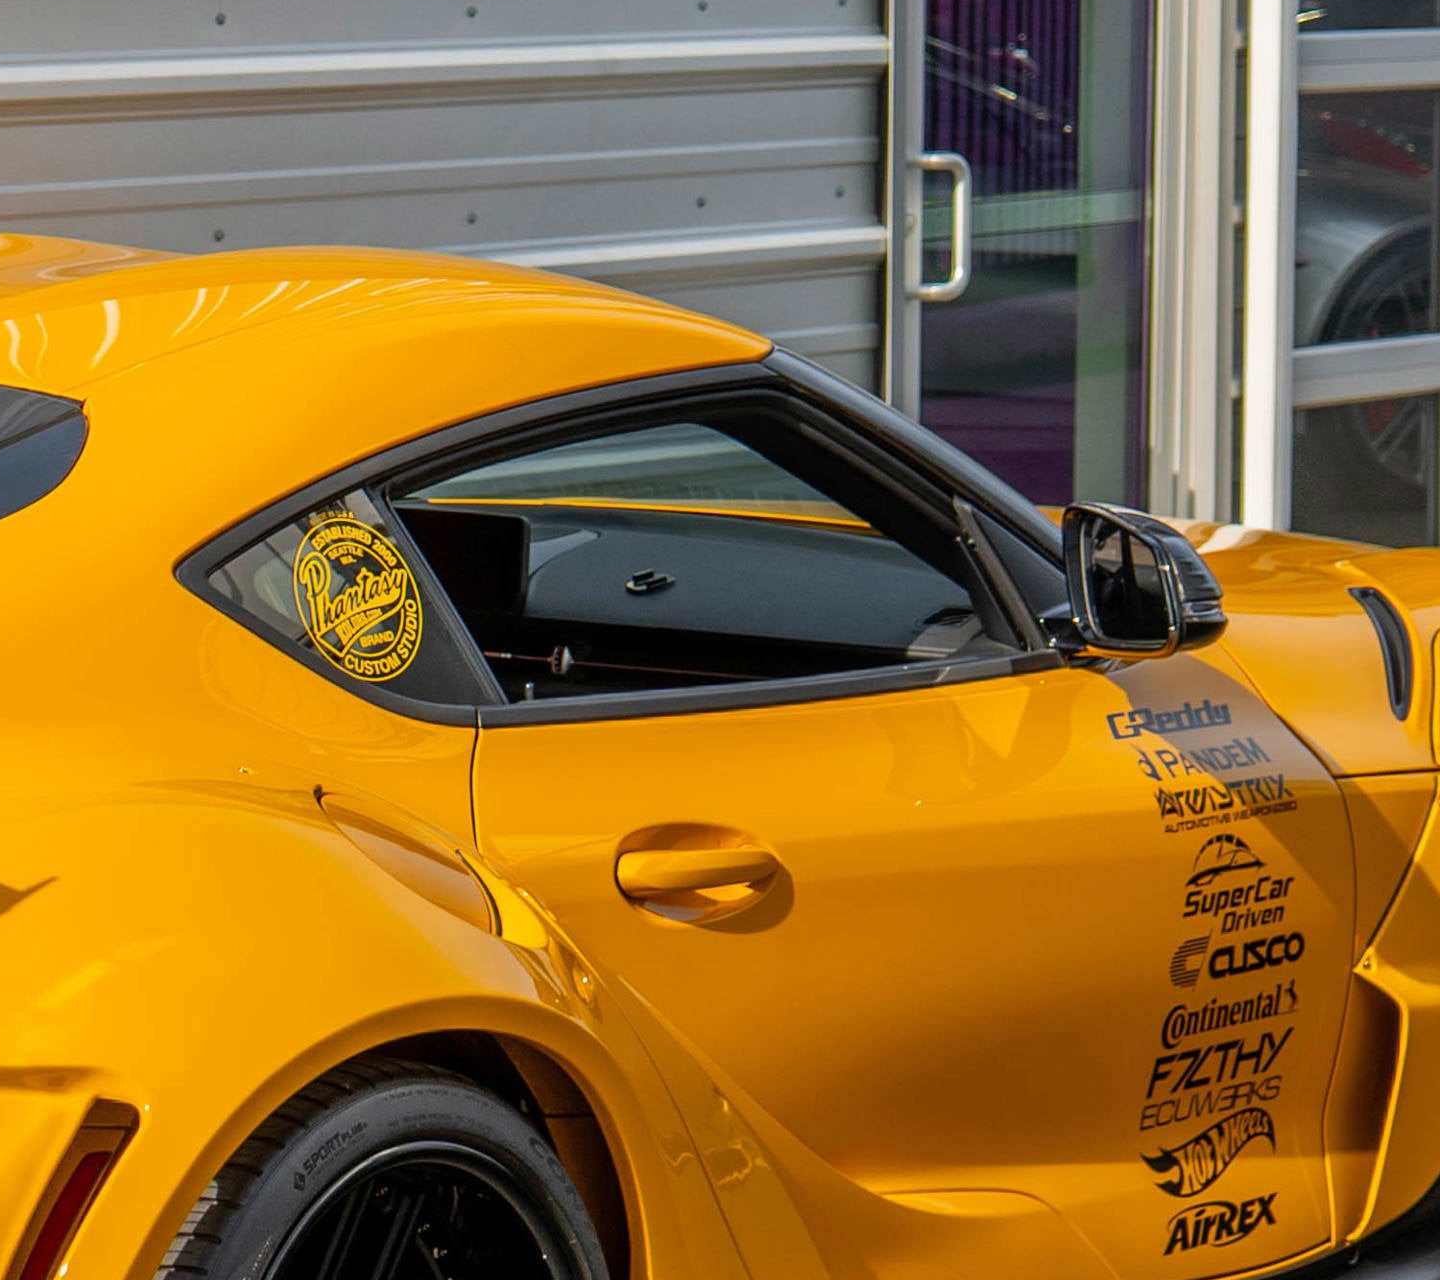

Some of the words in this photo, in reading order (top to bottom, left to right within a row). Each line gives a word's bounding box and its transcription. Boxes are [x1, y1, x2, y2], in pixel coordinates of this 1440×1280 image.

[311, 525, 372, 552] ESTABLISHED
[371, 539, 397, 566] 2000
[344, 652, 401, 675] CUSTOM
[397, 599, 417, 659] STUDIO
[360, 630, 394, 648] BRAND
[1155, 736, 1272, 778] PANDEM
[1182, 876, 1295, 918] SuperCar
[1221, 905, 1285, 934] Driven
[1208, 932, 1305, 980] CUSCO
[1162, 984, 1282, 1050] Continental
